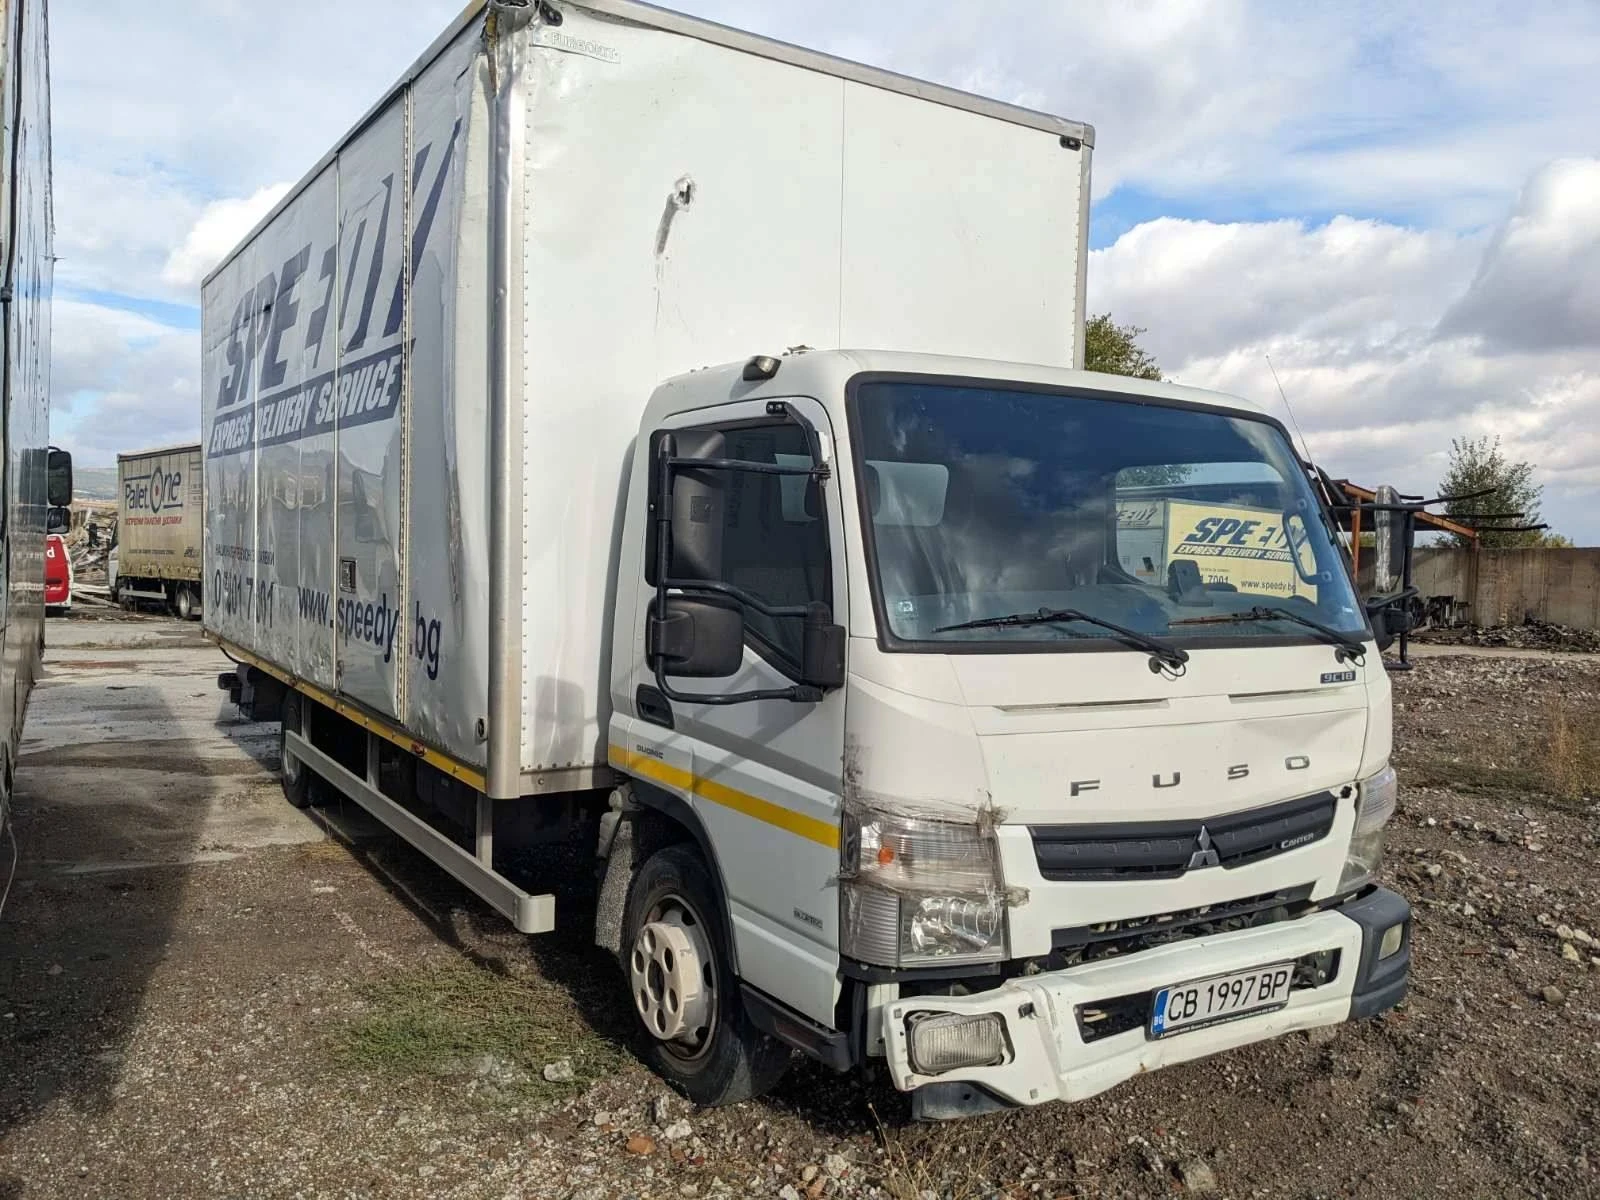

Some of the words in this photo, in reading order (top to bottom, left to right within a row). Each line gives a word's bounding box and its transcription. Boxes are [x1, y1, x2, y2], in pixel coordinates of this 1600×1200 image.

[216, 117, 463, 410] SPEEDY
[213, 418, 250, 452] EXPRESS
[253, 390, 316, 441] DELIVERY
[316, 360, 399, 421] SERVICE
[1178, 544, 1222, 556] EXPRESS
[1222, 547, 1264, 559] DELIVERY
[1323, 671, 1353, 682] 9C18
[1070, 755, 1311, 797] FUSO
[1153, 1014, 1164, 1025] BG
[1168, 989, 1198, 1021] CB
[1207, 976, 1257, 1014] 1997
[1258, 970, 1289, 1001] BP
